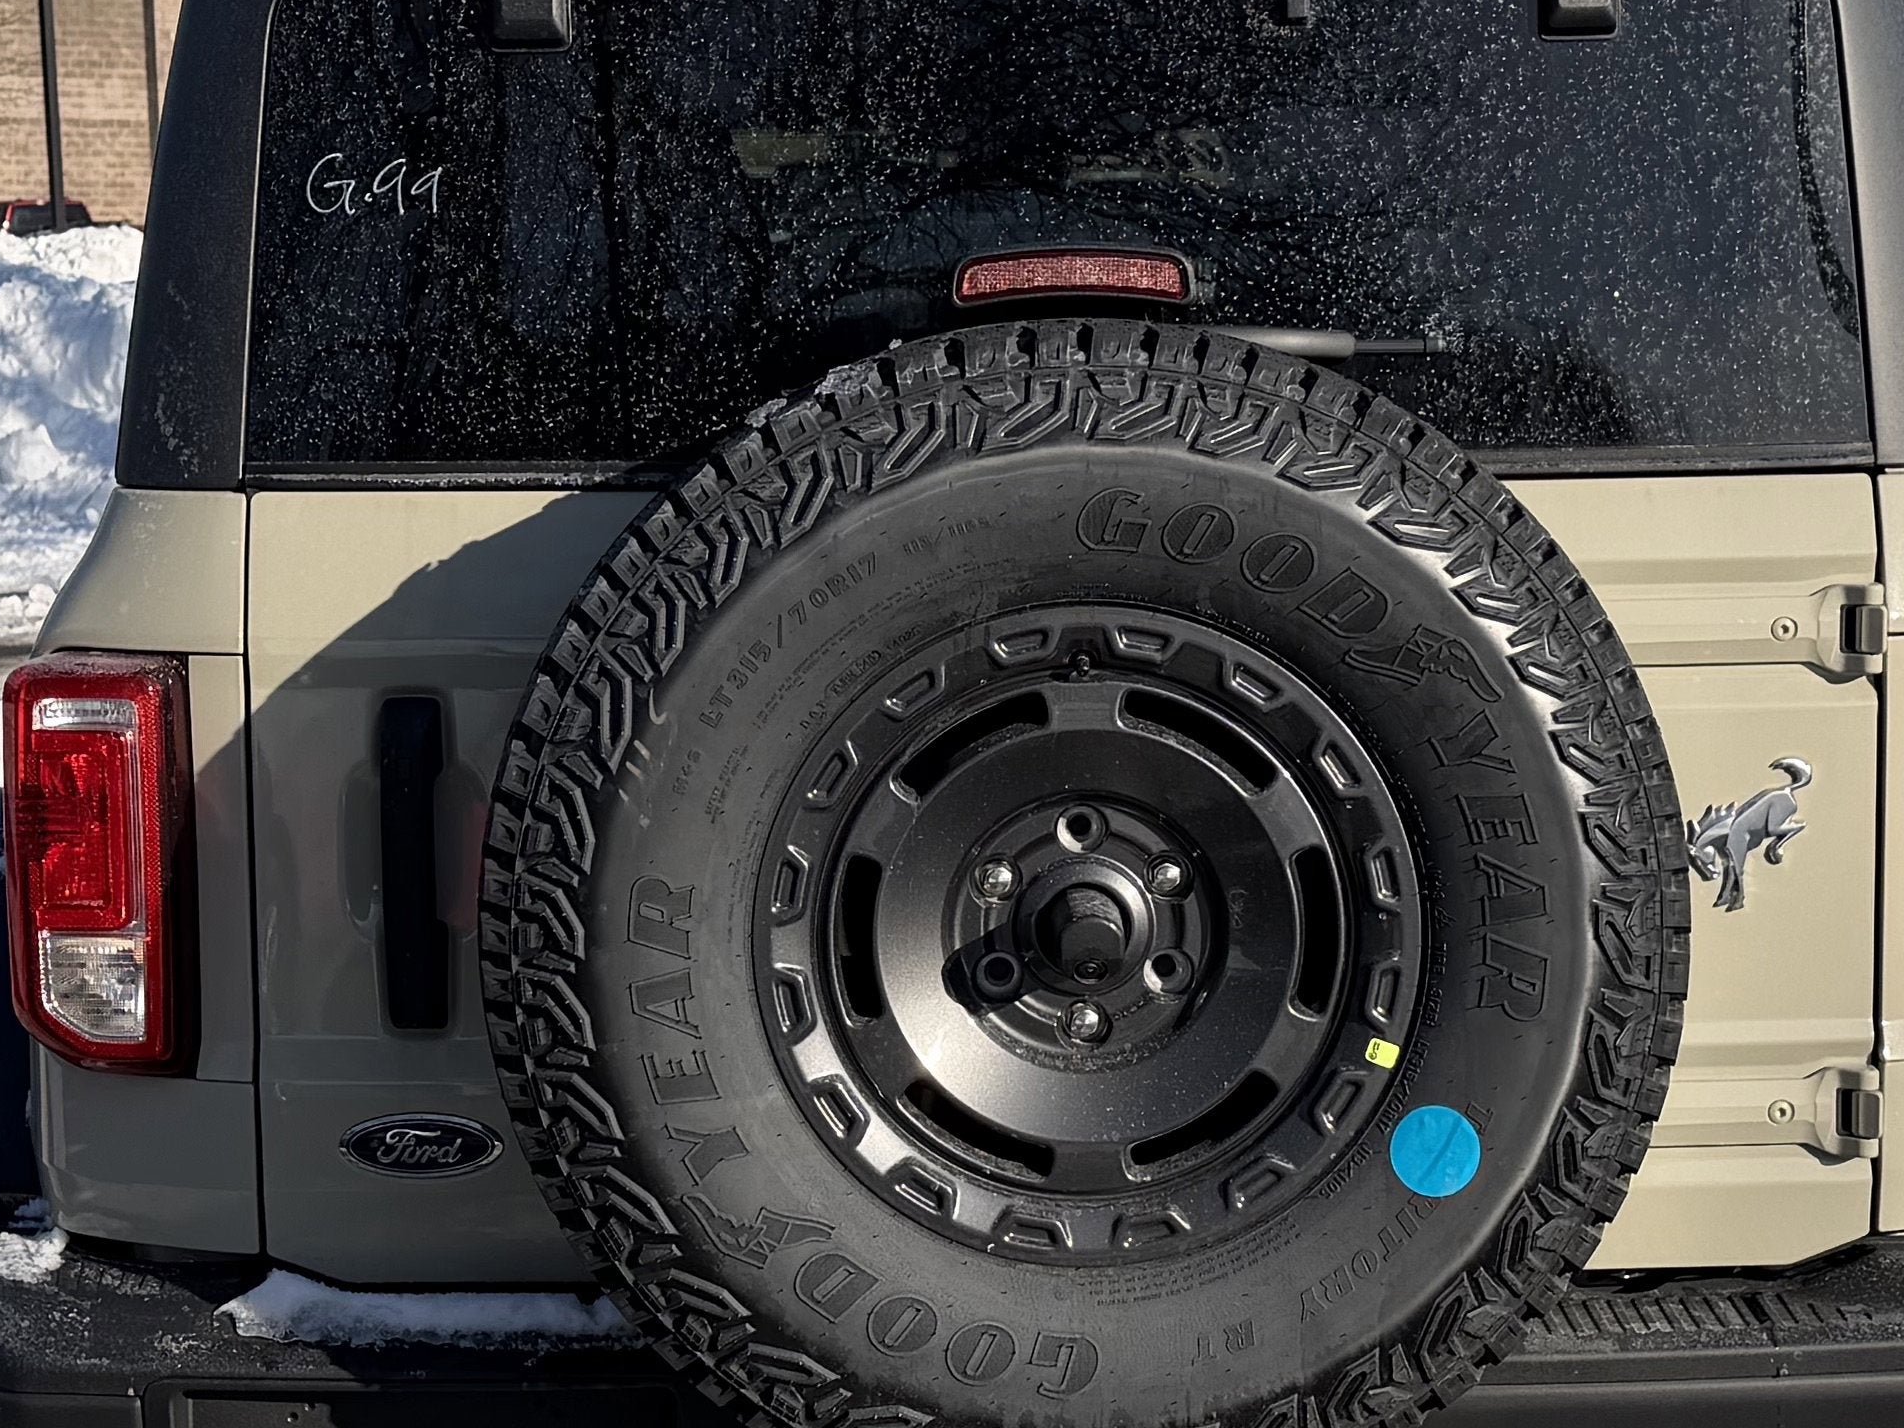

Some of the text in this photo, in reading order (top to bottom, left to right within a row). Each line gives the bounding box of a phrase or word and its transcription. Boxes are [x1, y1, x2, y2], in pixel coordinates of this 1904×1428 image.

[700, 550, 879, 729] LT315/70R17
[1078, 489, 1550, 1022] GOODYEAR
[377, 1129, 462, 1164] Ford
[629, 875, 1098, 1400] GOODYEAR
[1300, 1103, 1495, 1323] TRITORY
